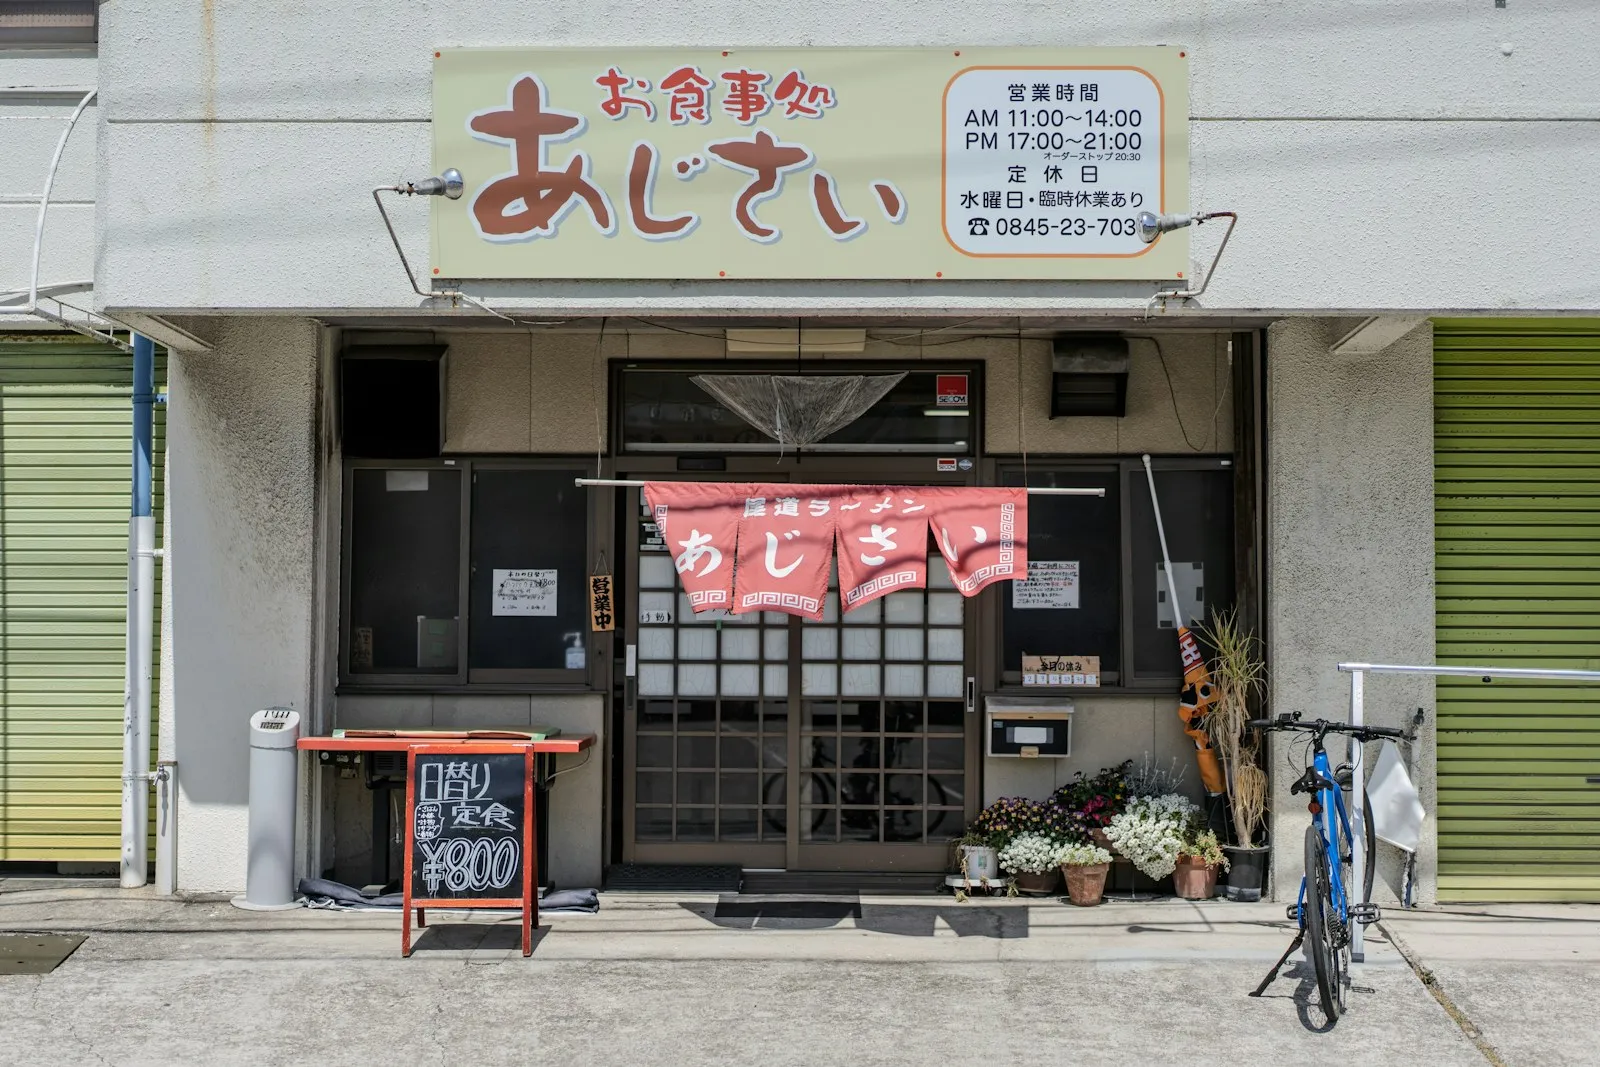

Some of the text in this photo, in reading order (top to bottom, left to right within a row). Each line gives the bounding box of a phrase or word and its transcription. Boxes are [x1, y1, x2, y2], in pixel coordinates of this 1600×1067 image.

[595, 66, 834, 122] お食事処
[1008, 83, 1099, 102] 営業時間
[964, 109, 1142, 127] AM 11:00～14:00
[965, 132, 1142, 150] PM 17:00～21:00
[470, 74, 905, 240] あじさい
[1043, 152, 1141, 161] オーダーストップ 20:30
[1008, 165, 1099, 183] 定休日
[960, 190, 1143, 209] 水曜日・臨時休業あり
[996, 217, 1137, 236] 0845-23-703
[938, 395, 966, 403] SECOM
[675, 522, 988, 579] あじさい
[592, 577, 611, 629] 営業中
[419, 761, 493, 801] 日替り
[451, 801, 517, 830] 定食
[417, 837, 519, 893] ¥800
